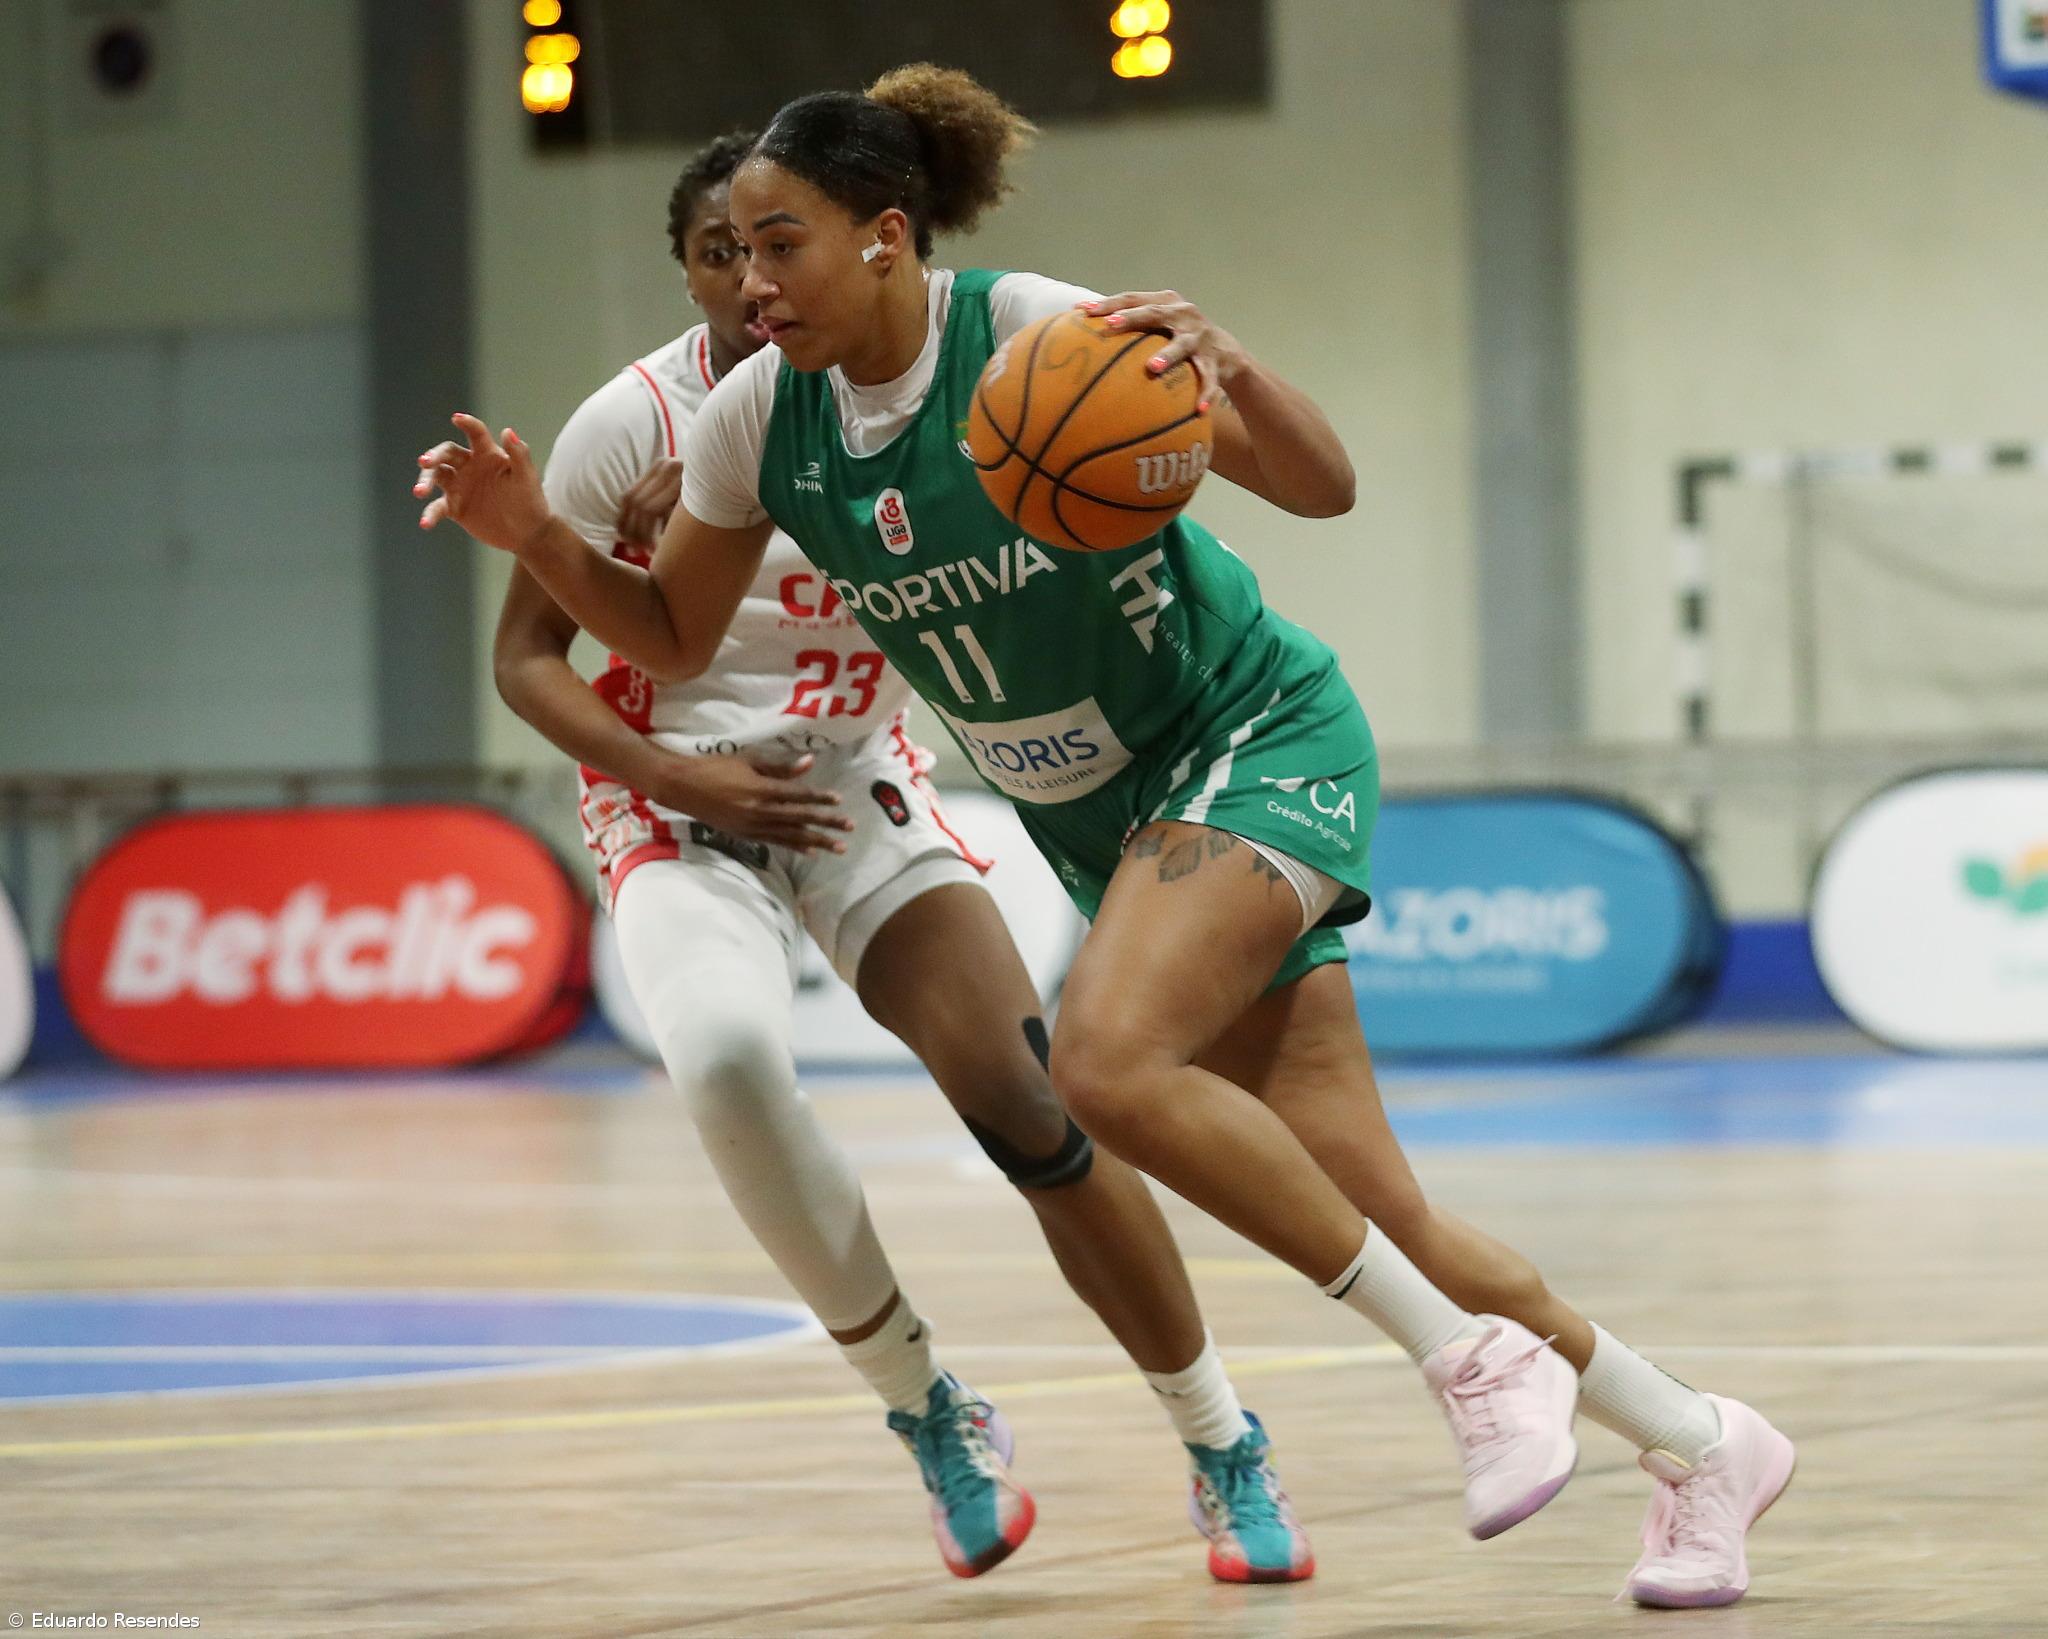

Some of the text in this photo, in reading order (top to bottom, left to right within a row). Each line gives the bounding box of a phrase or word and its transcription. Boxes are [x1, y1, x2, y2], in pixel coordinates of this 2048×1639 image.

[820, 537, 1059, 622] PORTIVA
[781, 649, 885, 719] 23
[919, 624, 1007, 703] 11
[1267, 800, 1313, 828] Crédito
[1309, 779, 1355, 832] CA
[107, 876, 533, 1002] Betclic
